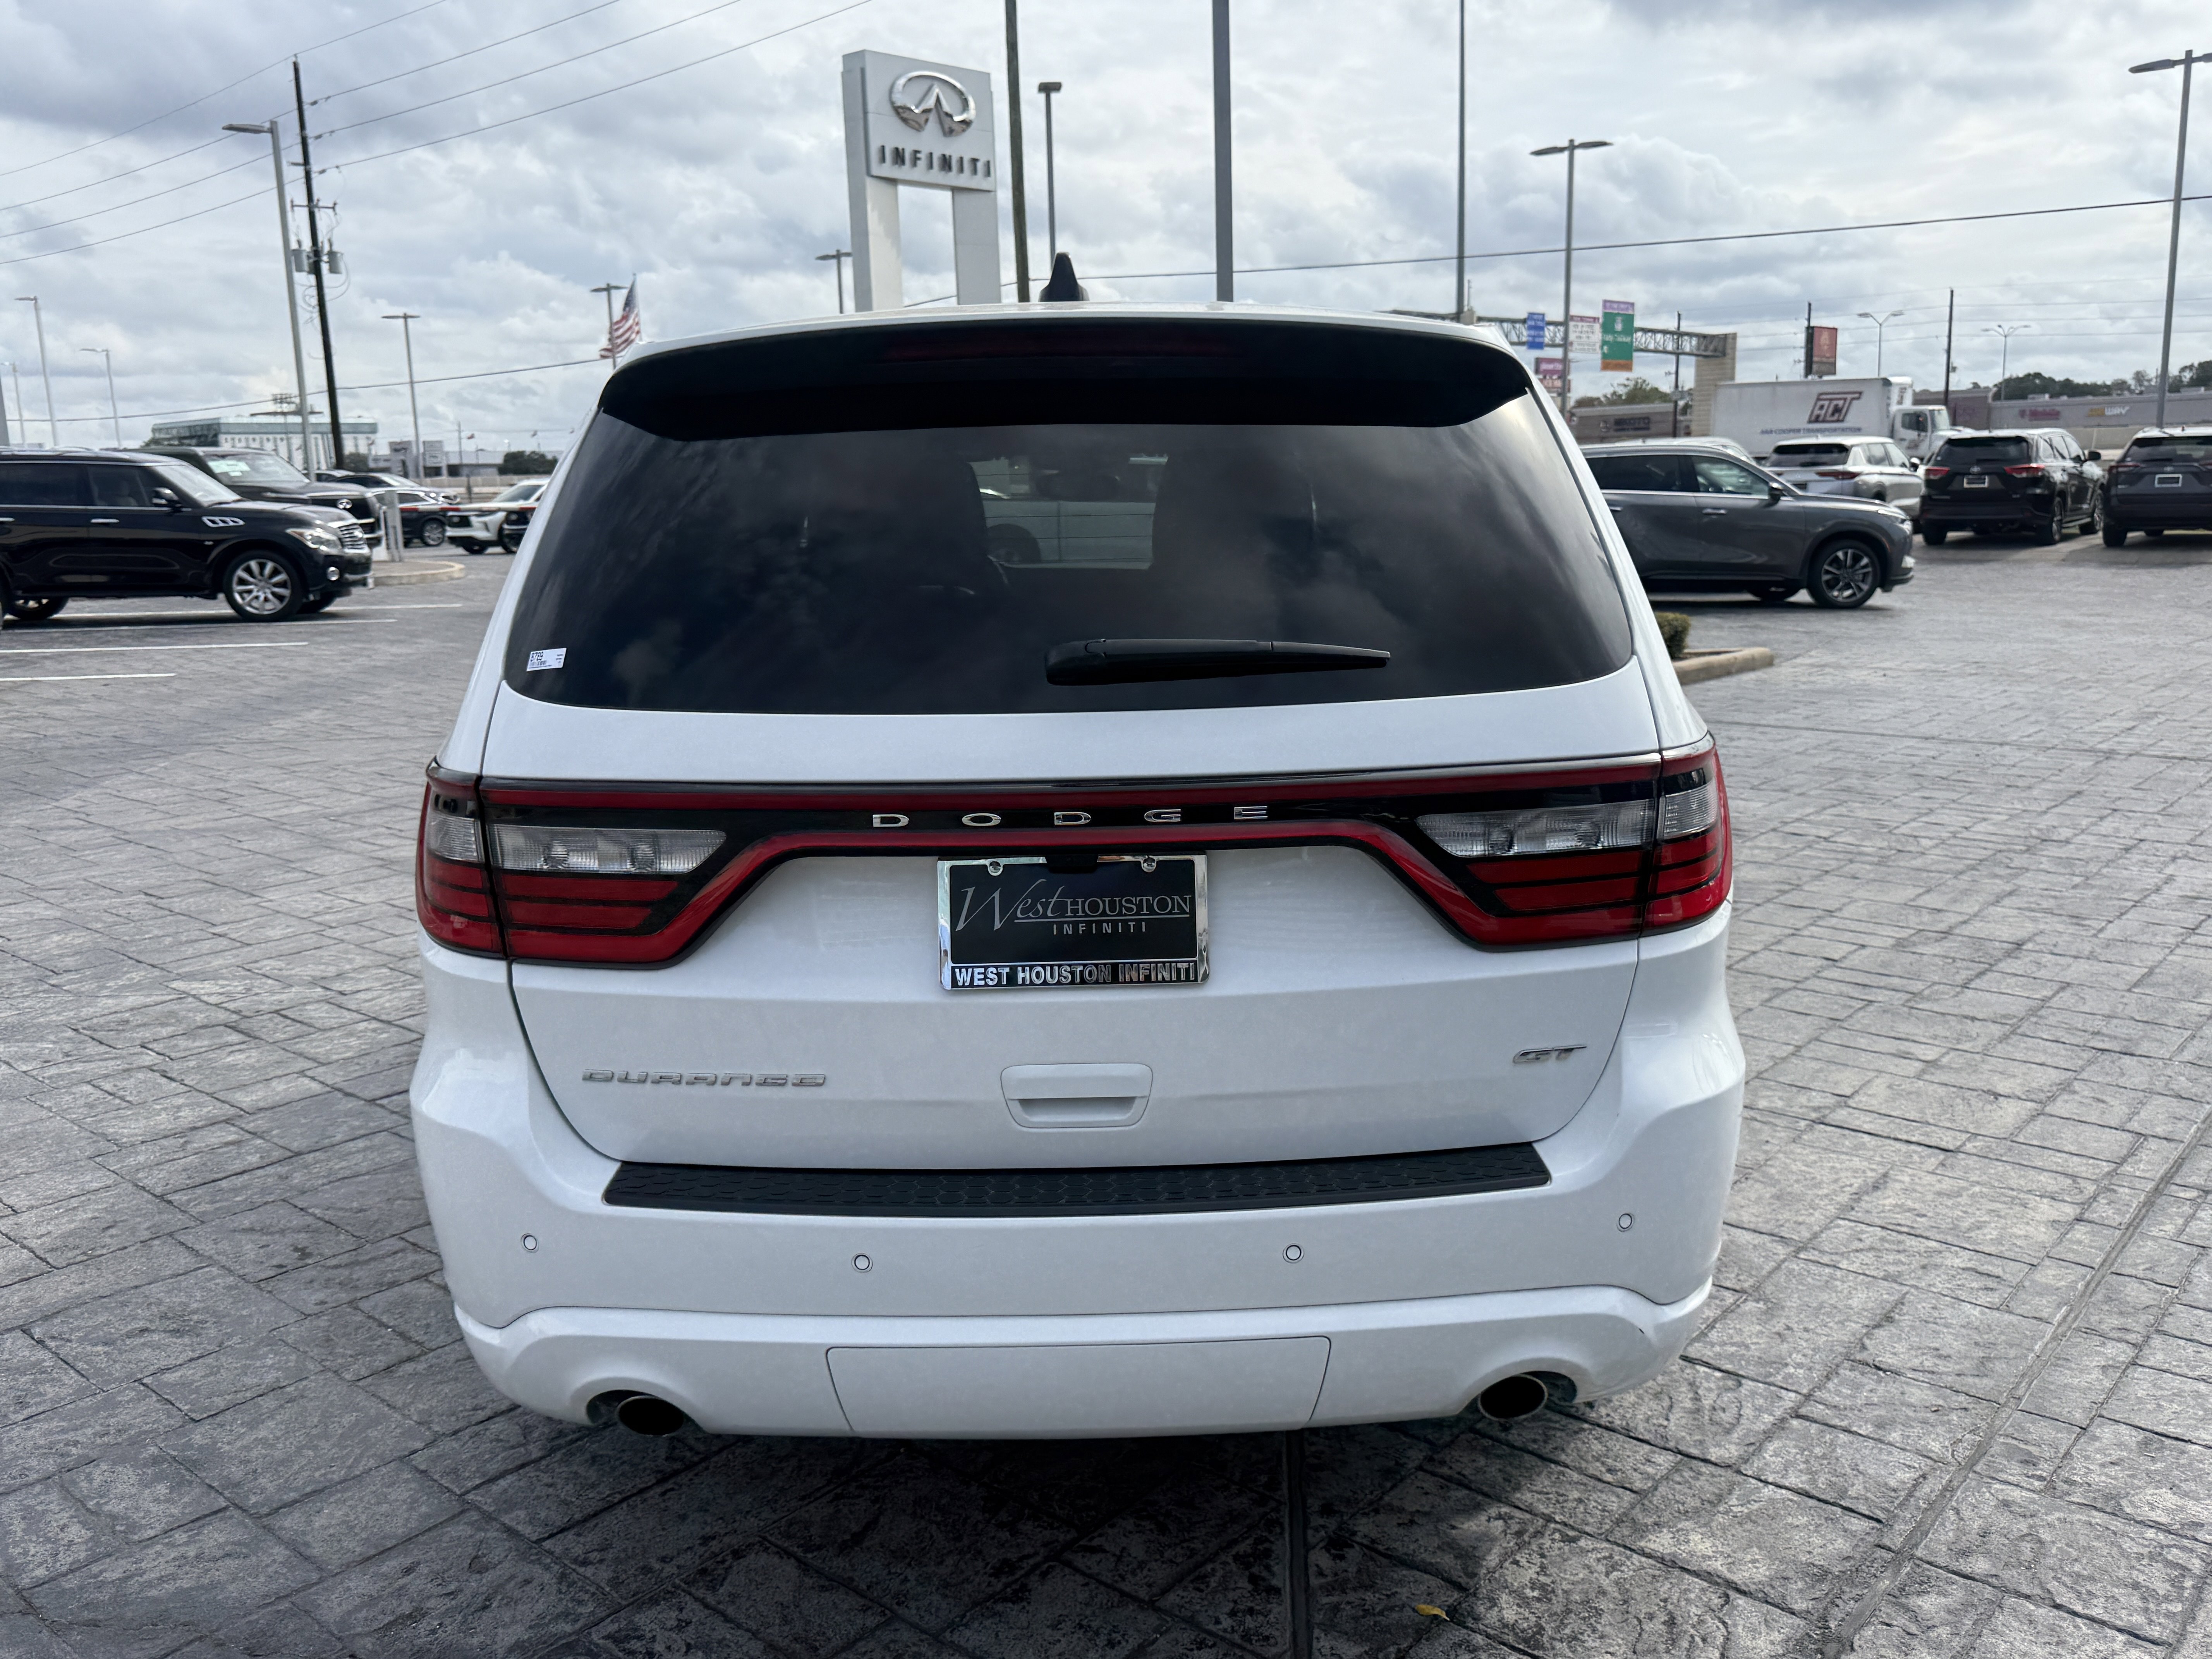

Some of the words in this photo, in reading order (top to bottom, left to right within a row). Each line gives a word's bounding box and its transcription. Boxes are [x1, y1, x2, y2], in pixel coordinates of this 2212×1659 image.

[878, 144, 991, 178] INFINITI
[1807, 391, 1863, 423] ACT
[873, 806, 1268, 828] DODGE
[1065, 895, 1192, 917] HOUSTON
[1053, 921, 1146, 935] INFINITI
[955, 966, 1010, 986] WEST
[1017, 964, 1112, 985] HOUSTON
[1118, 962, 1196, 982] INFINITI
[1512, 1045, 1587, 1064] GT
[582, 1069, 826, 1087] DURANGO
